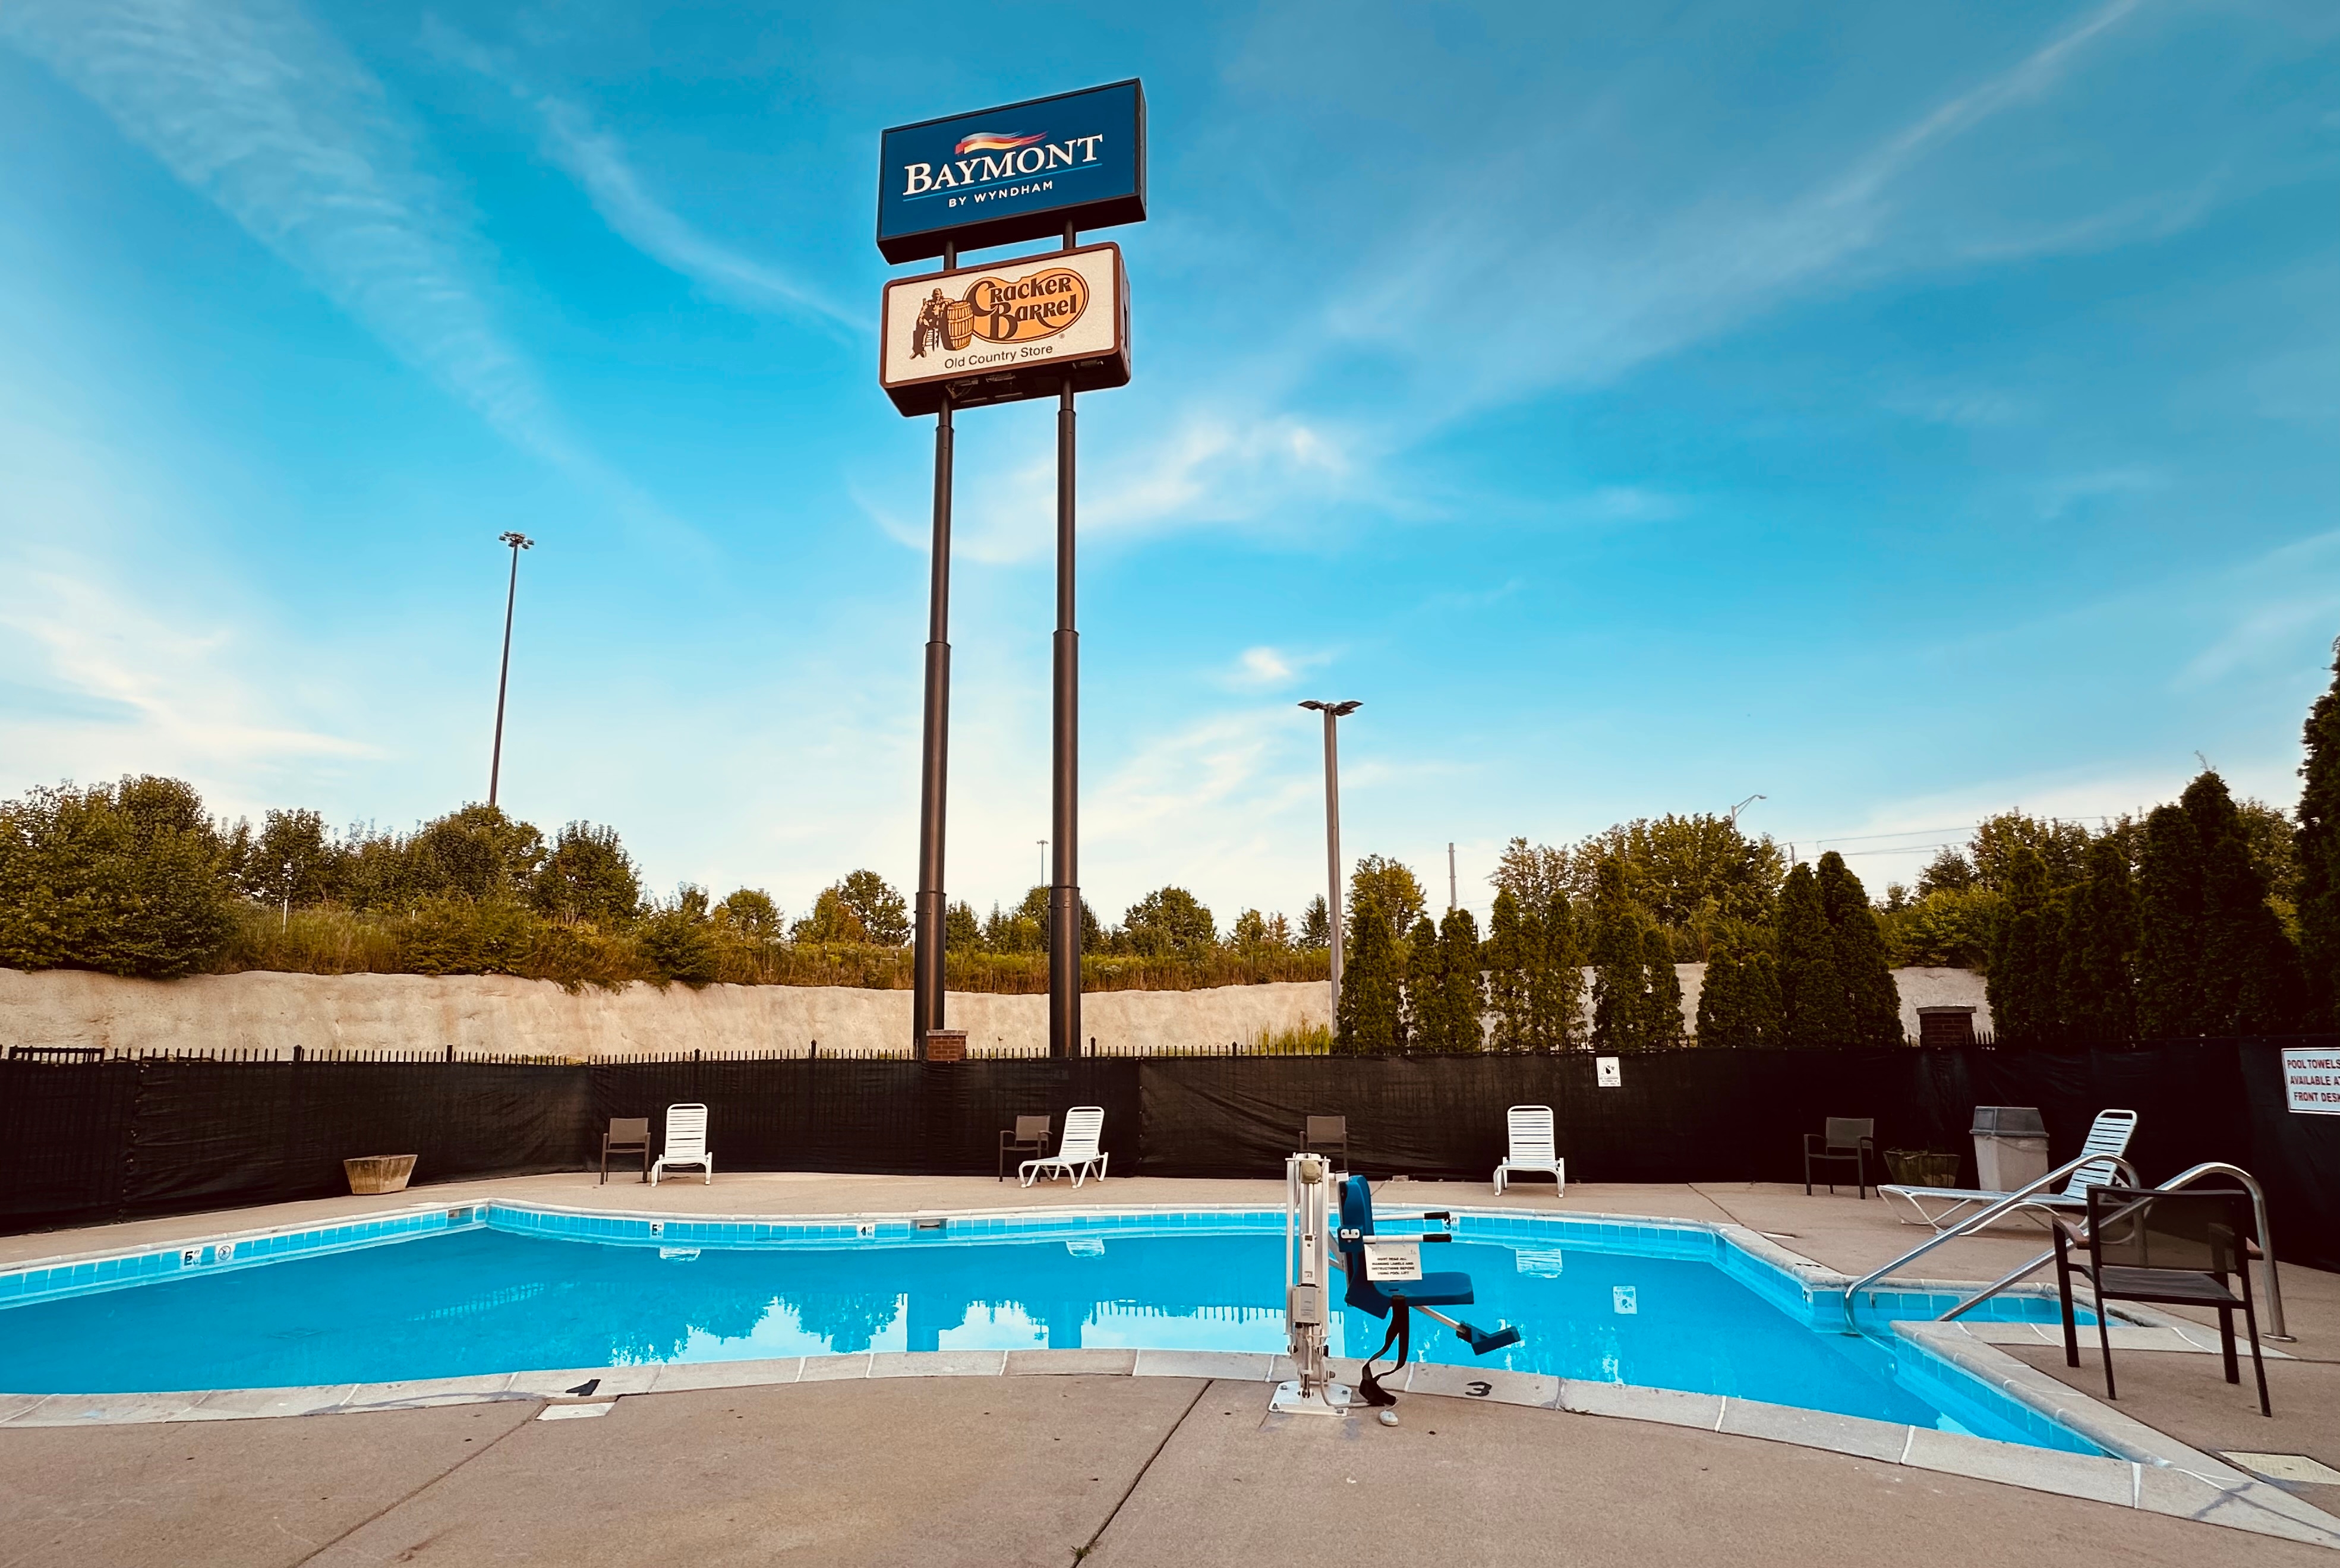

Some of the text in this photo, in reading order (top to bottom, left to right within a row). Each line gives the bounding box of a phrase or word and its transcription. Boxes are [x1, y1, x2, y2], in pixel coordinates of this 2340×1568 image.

[902, 134, 1103, 197] BAYMONT
[948, 180, 1054, 208] BY WYNDHAM
[966, 277, 1073, 317] Cracker
[989, 294, 1077, 340] Barrel
[944, 345, 1054, 369] Old Country Store
[2287, 1059, 2340, 1068] POOL TOWELS
[2290, 1075, 2332, 1086] AVAILABLE
[2293, 1091, 2318, 1102] FRONT
[1465, 1381, 1493, 1397] 3
